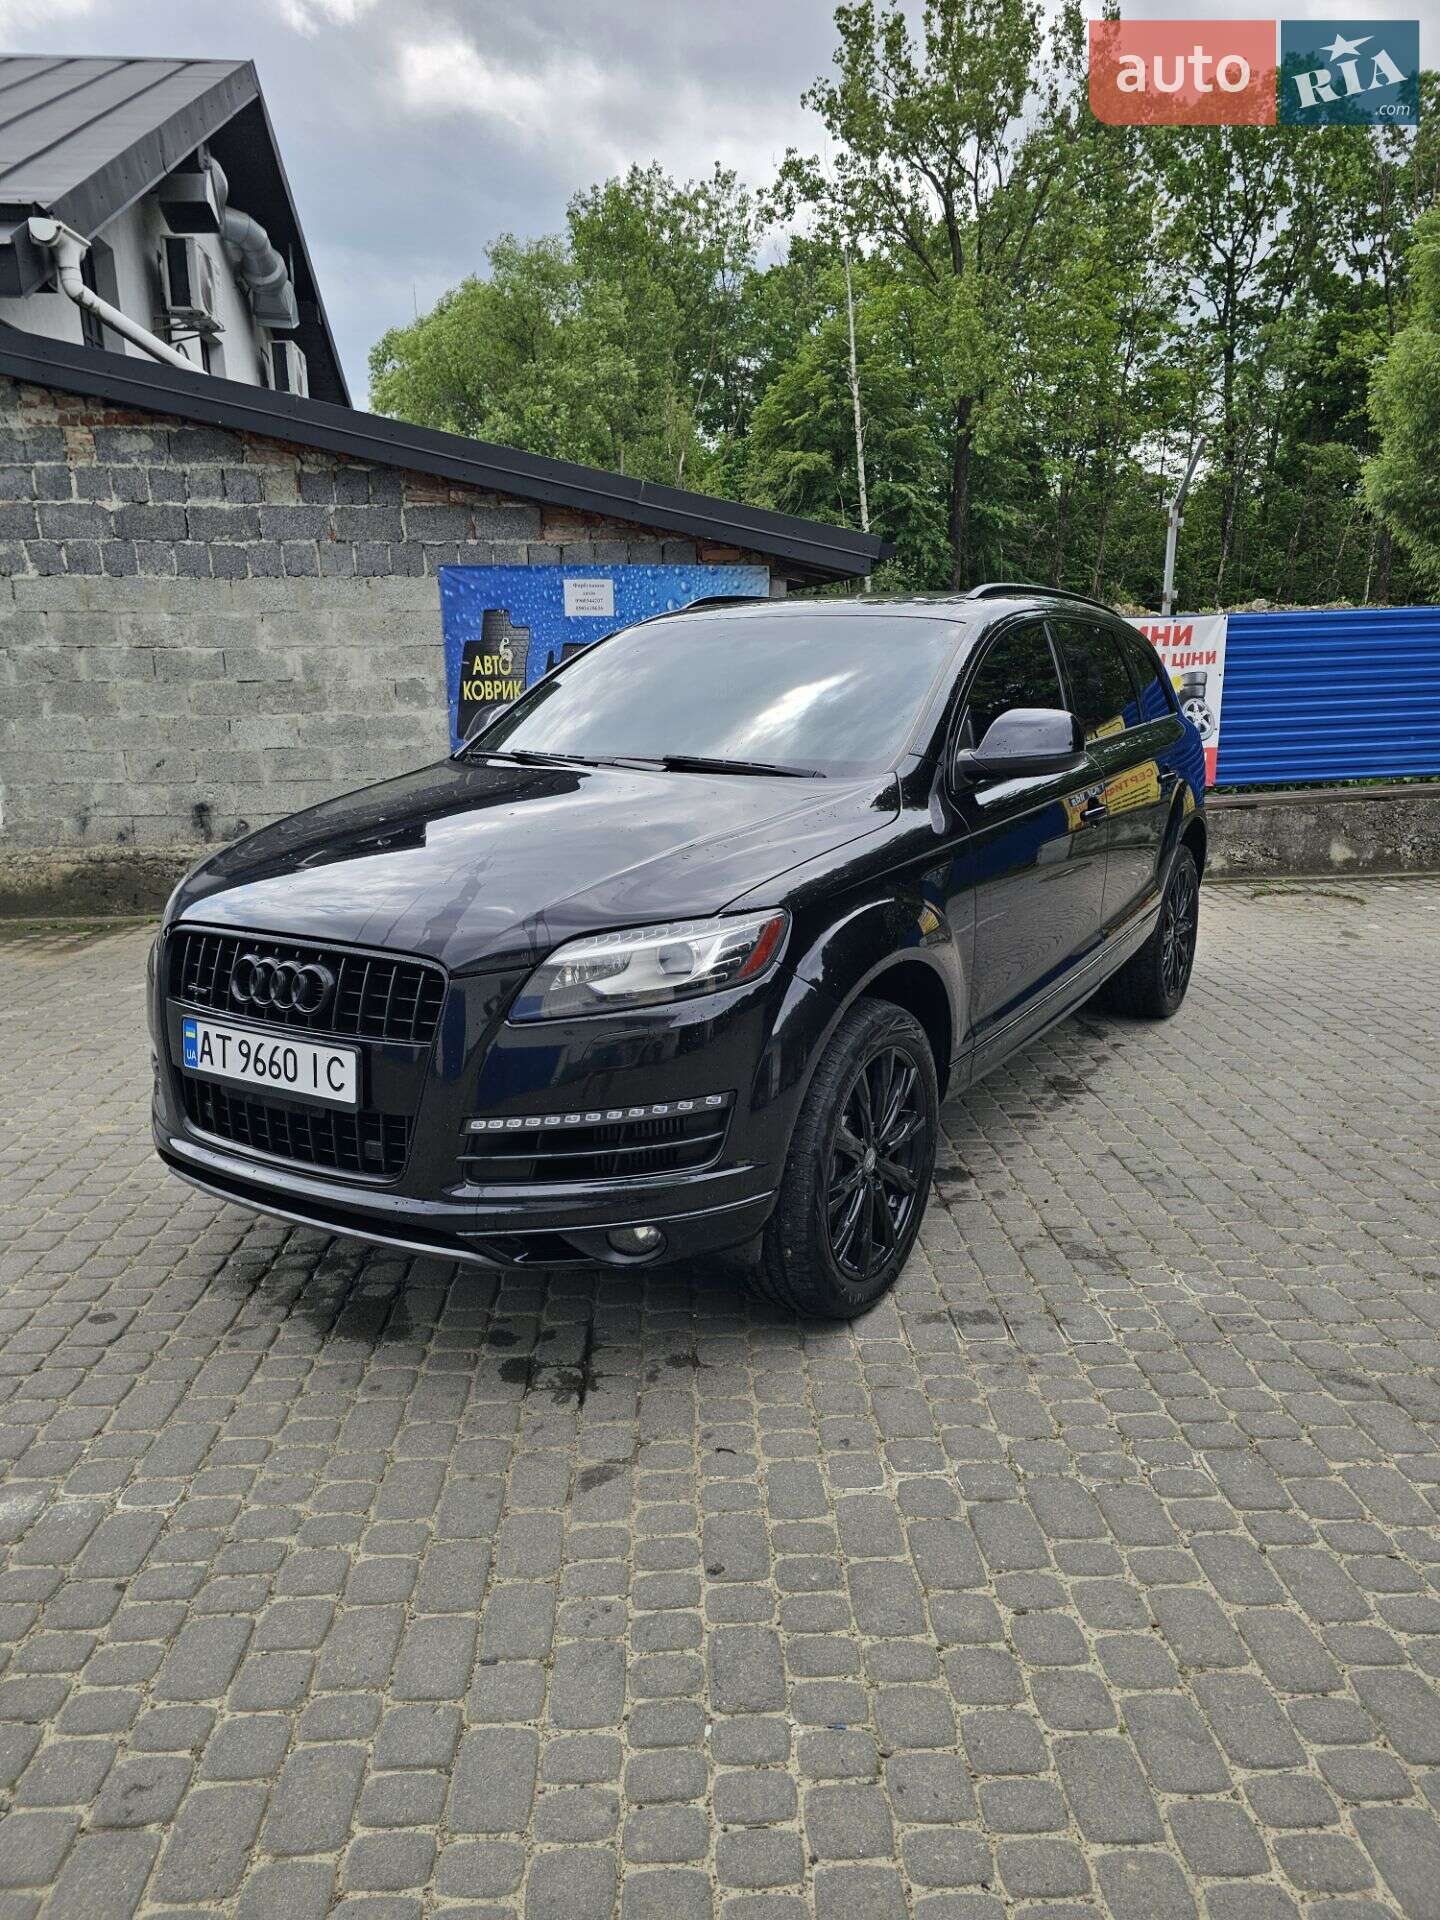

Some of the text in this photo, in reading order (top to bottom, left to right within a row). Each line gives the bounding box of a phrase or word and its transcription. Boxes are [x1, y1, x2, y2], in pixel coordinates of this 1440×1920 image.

[472, 655, 513, 676] АВТО
[1171, 650, 1217, 669] ЦІНИ
[186, 1049, 197, 1061] UA
[200, 1030, 345, 1092] AT 9660 IC
